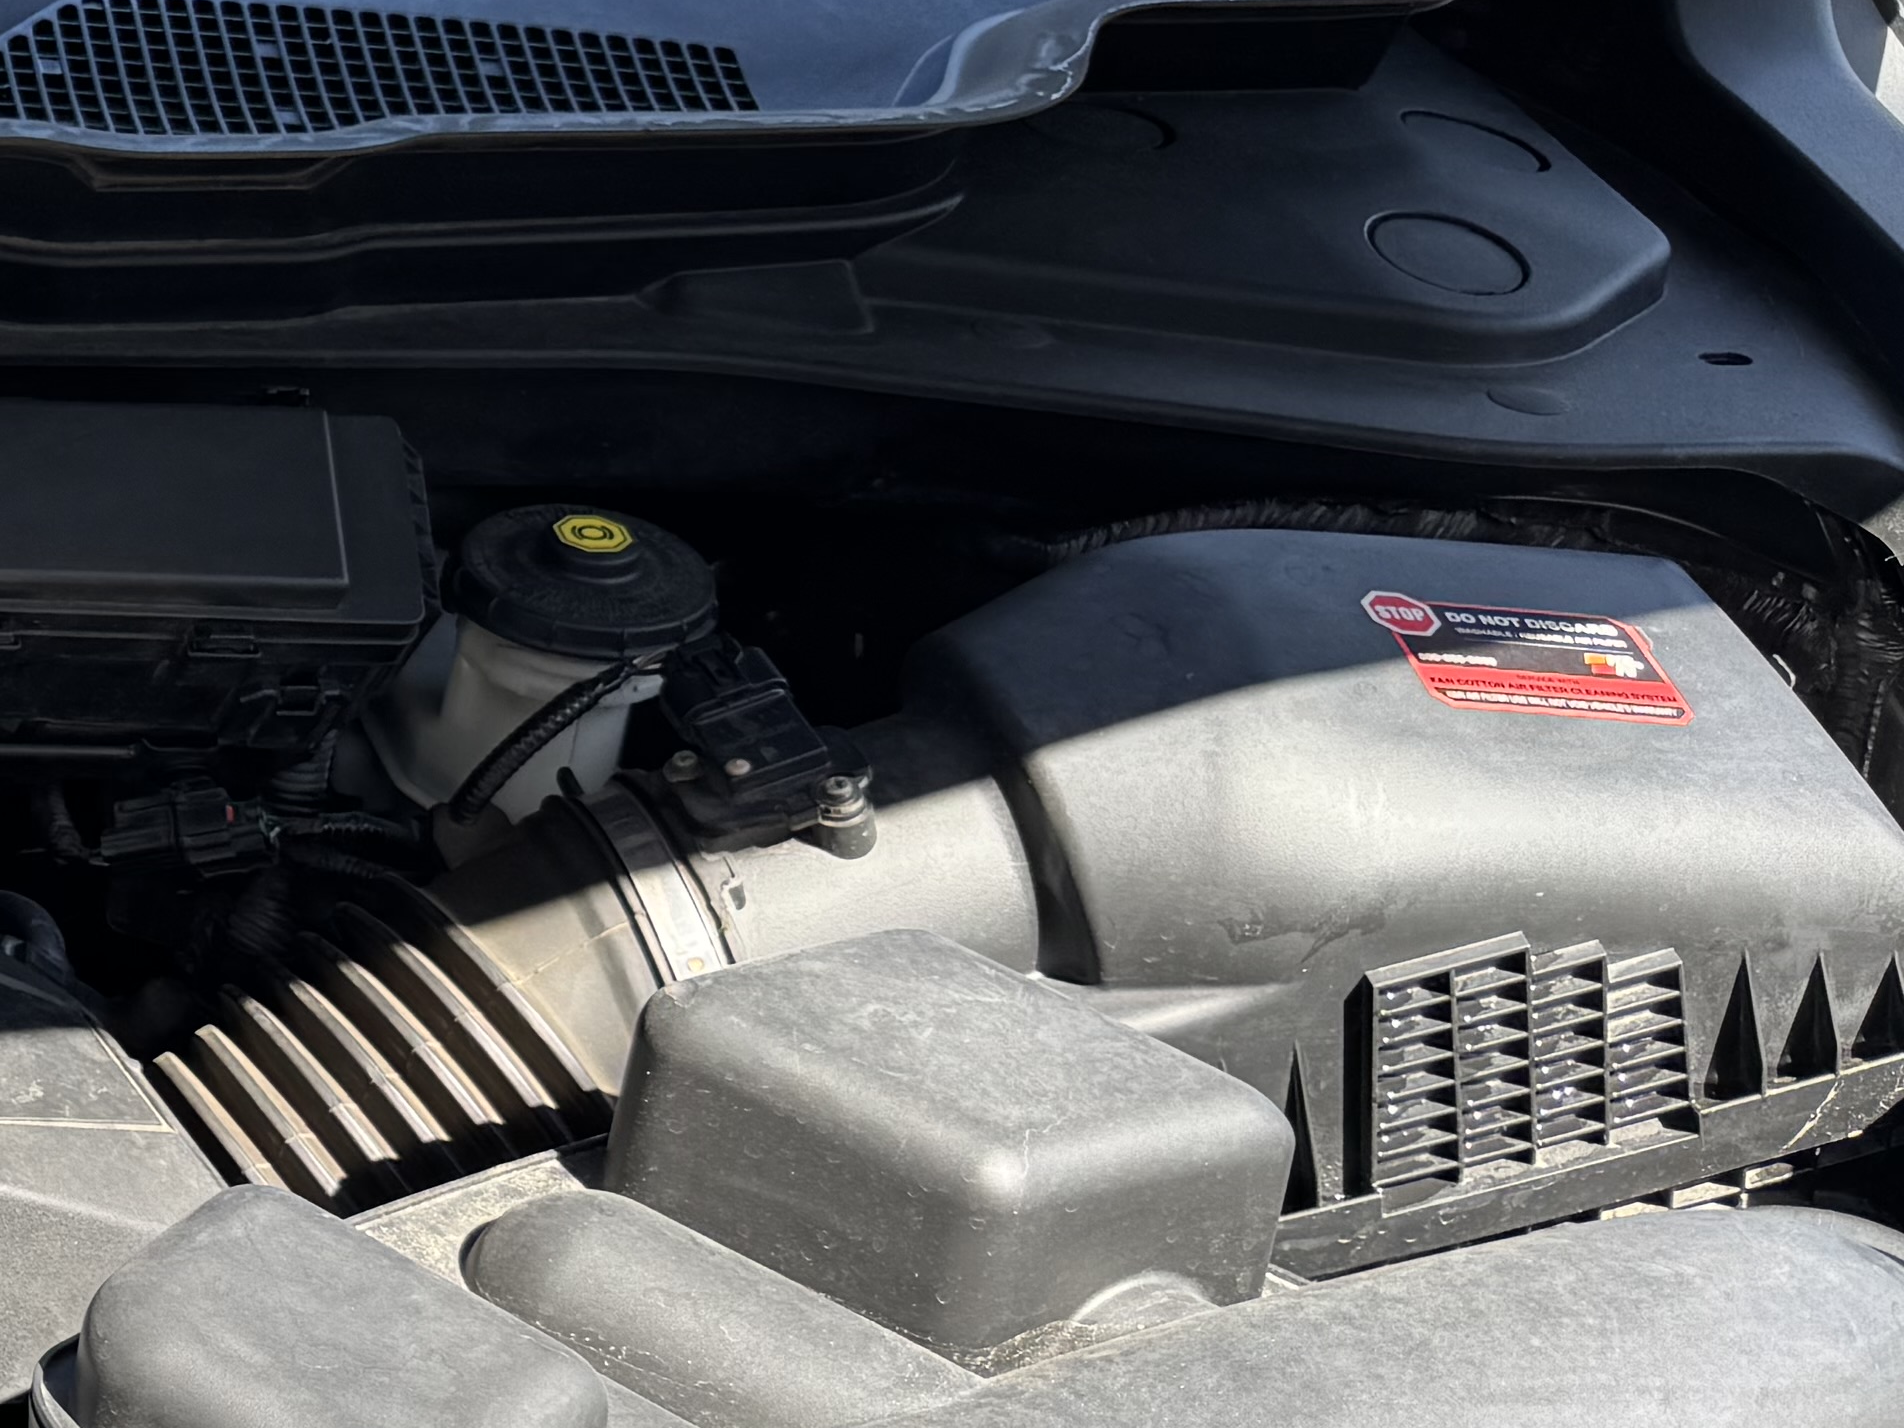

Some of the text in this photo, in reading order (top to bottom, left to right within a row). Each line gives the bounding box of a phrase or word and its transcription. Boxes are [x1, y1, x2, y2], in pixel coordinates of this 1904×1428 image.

[1374, 605, 1425, 621] STOP
[1445, 612, 1619, 637] DO NOT DISCARD
[1456, 678, 1505, 689] COTTON
[1508, 682, 1527, 691] AIR
[1529, 684, 1570, 694] FILTER
[1571, 687, 1630, 699] CLEANING
[1630, 692, 1677, 703] SYSTEM
